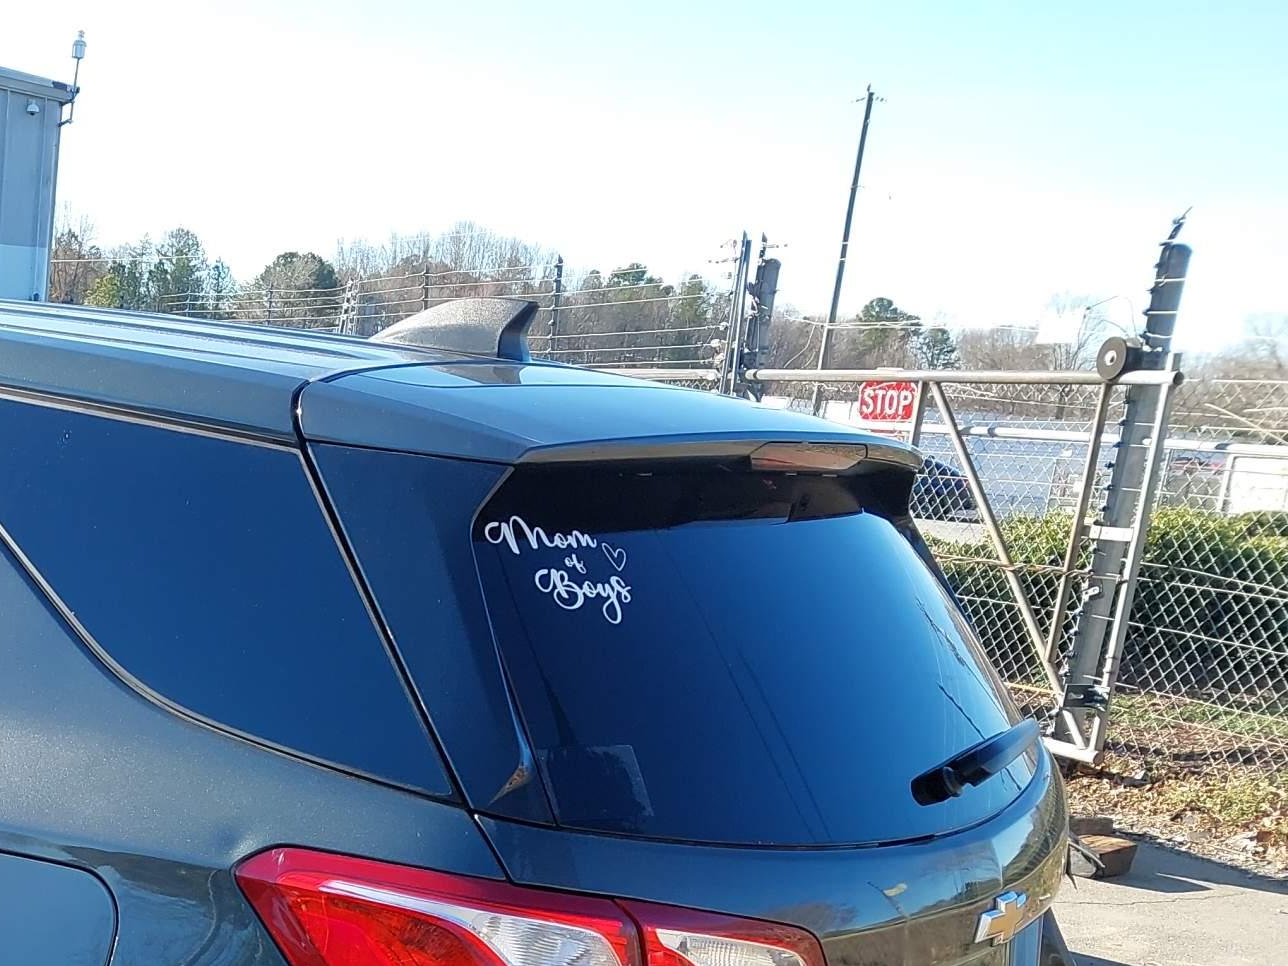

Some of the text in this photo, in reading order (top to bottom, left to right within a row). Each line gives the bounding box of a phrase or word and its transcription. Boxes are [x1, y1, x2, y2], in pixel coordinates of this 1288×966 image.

[862, 388, 913, 415] STOP
[484, 515, 597, 555] Mom
[564, 553, 586, 574] of
[534, 568, 632, 625] Boys
